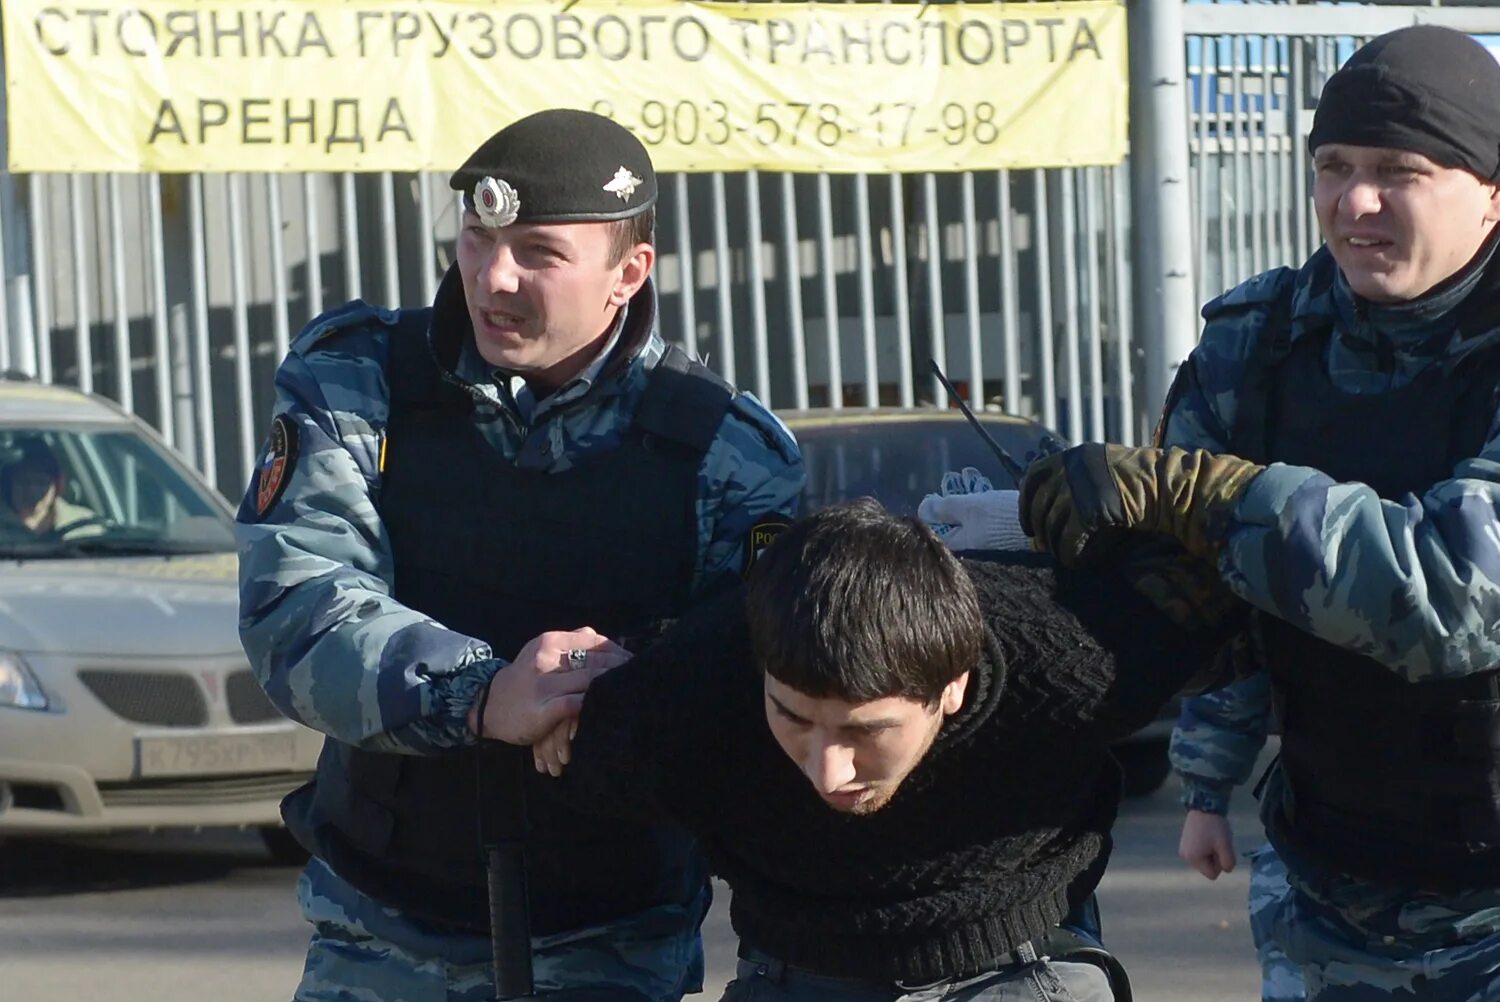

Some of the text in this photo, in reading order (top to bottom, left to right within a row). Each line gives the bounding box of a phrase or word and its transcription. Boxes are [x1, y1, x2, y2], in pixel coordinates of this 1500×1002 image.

[35, 9, 1102, 66] СТОЯНКА ГРУЗОВОГО ТРАНСПОРТА
[148, 98, 414, 153] АРЕНДА
